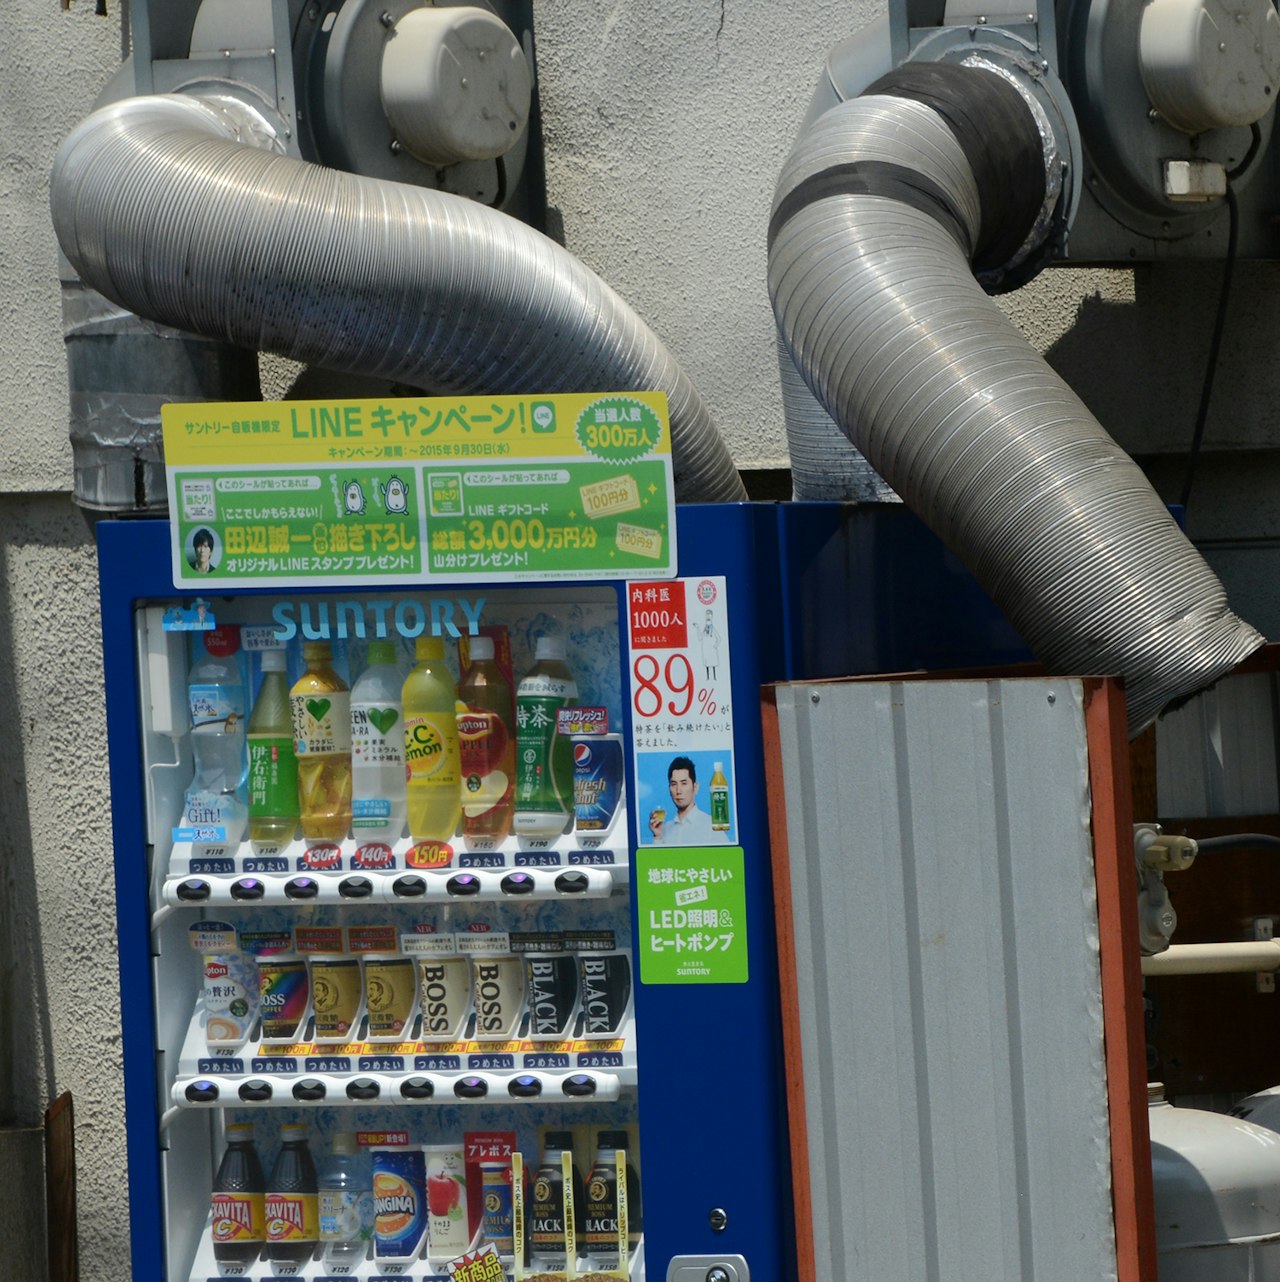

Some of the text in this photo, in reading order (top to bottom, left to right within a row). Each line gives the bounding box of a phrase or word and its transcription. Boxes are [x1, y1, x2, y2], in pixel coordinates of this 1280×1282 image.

[290, 402, 527, 439] LINE キャンペーン!
[586, 424, 652, 448] 300万人
[468, 505, 494, 516] LINE
[433, 552, 529, 568] 山分けプレゼント!
[632, 587, 671, 603] 内科医
[271, 597, 487, 642] SUNTORY
[632, 611, 684, 629] 1000人
[187, 807, 222, 824] Gift!
[306, 847, 338, 863] 130円
[359, 846, 388, 863] 140円
[413, 845, 448, 864] 150円
[462, 857, 503, 867] つめたい
[517, 856, 559, 867] つめたい
[571, 855, 613, 865] つめたい
[192, 862, 234, 873] つめたい
[246, 861, 286, 872] つめたい
[648, 867, 733, 885] 地球にやさしい
[651, 932, 735, 953] ヒートポンプ
[424, 964, 450, 1033] BOSS
[478, 963, 503, 1032] BOSS
[531, 961, 559, 1035] BLACK
[583, 958, 611, 1034] BLACK
[201, 1063, 242, 1073] つめたい
[255, 1062, 295, 1072] つめたい
[308, 1061, 348, 1071] つめたい
[362, 1060, 402, 1070] つめたい
[418, 1060, 458, 1070] つめたい
[471, 1059, 512, 1069] つめたい
[527, 1058, 567, 1068] つめたい
[580, 1057, 621, 1067] つめたい
